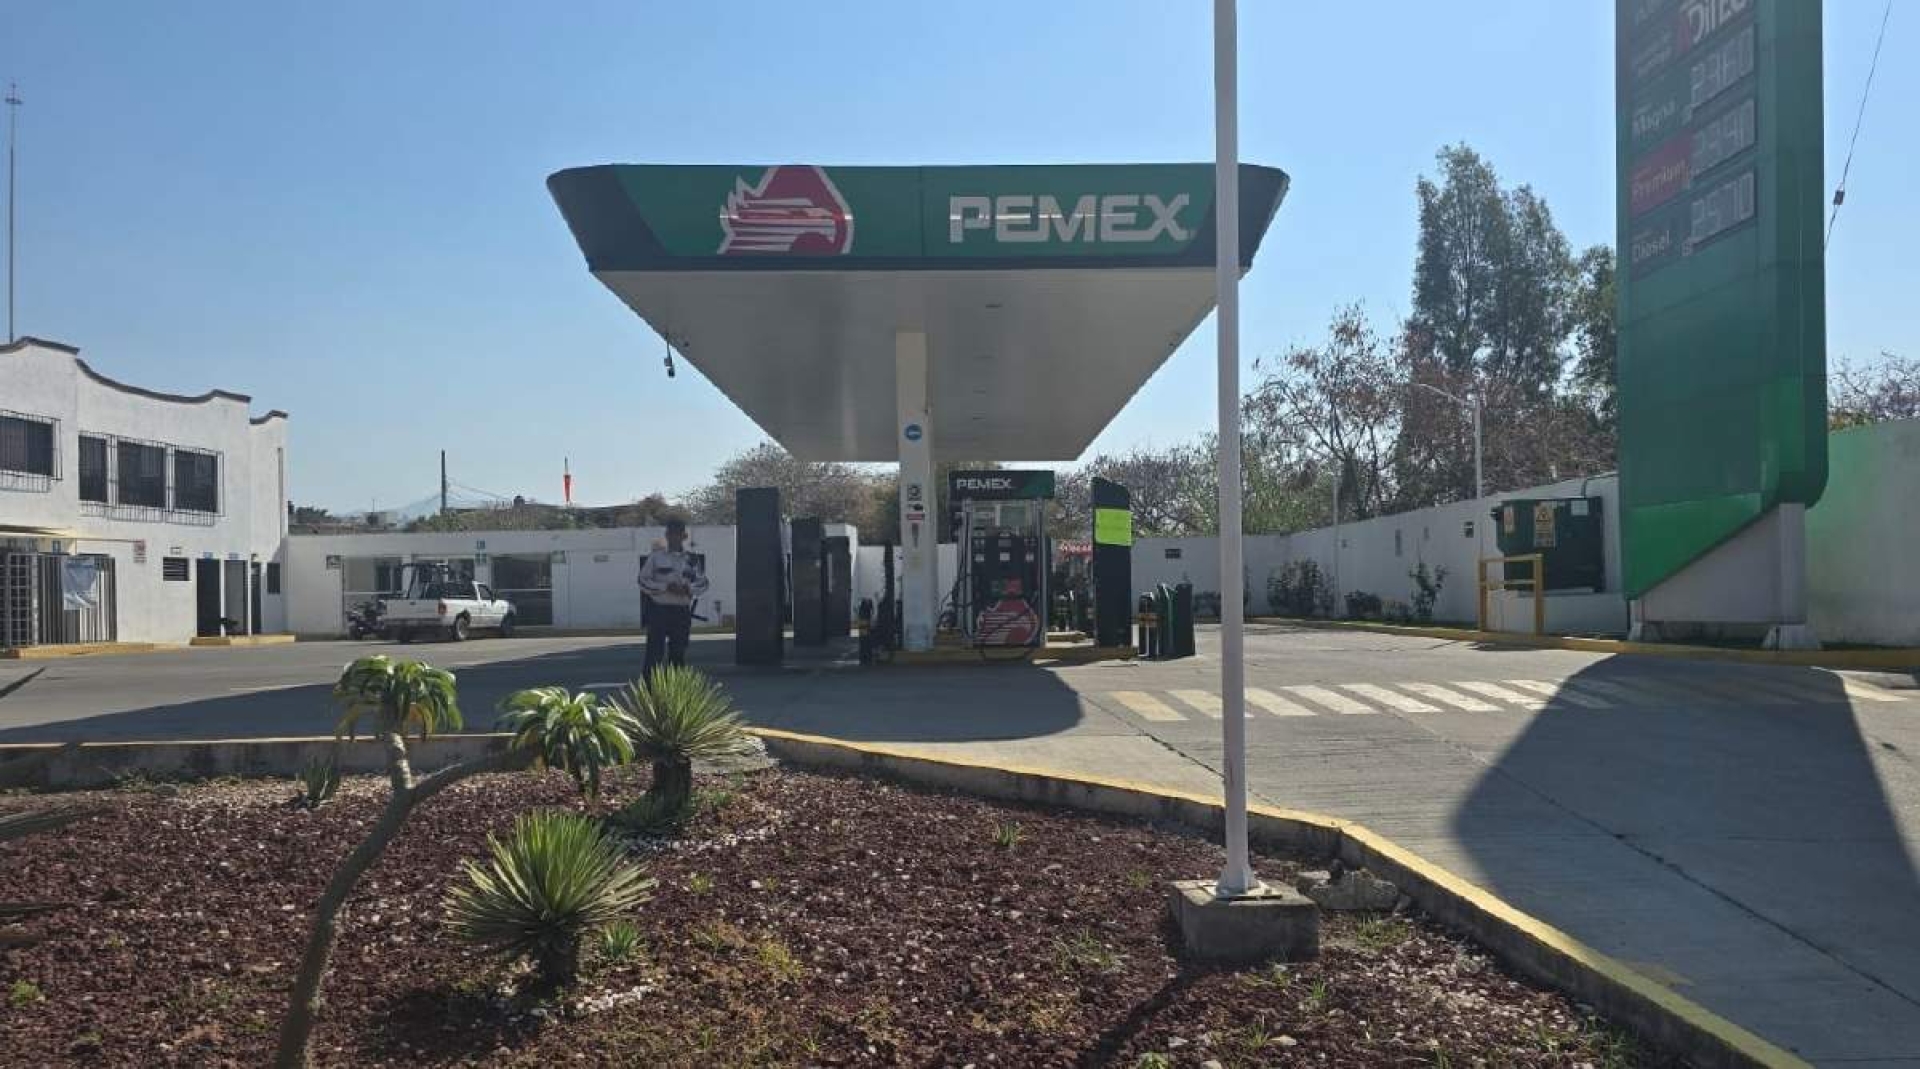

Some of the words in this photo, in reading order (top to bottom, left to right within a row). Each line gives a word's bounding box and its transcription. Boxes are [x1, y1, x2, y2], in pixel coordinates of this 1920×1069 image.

[1632, 159, 1690, 198] Premium
[950, 193, 1190, 243] PEMEX
[956, 478, 1012, 489] PEMEX
